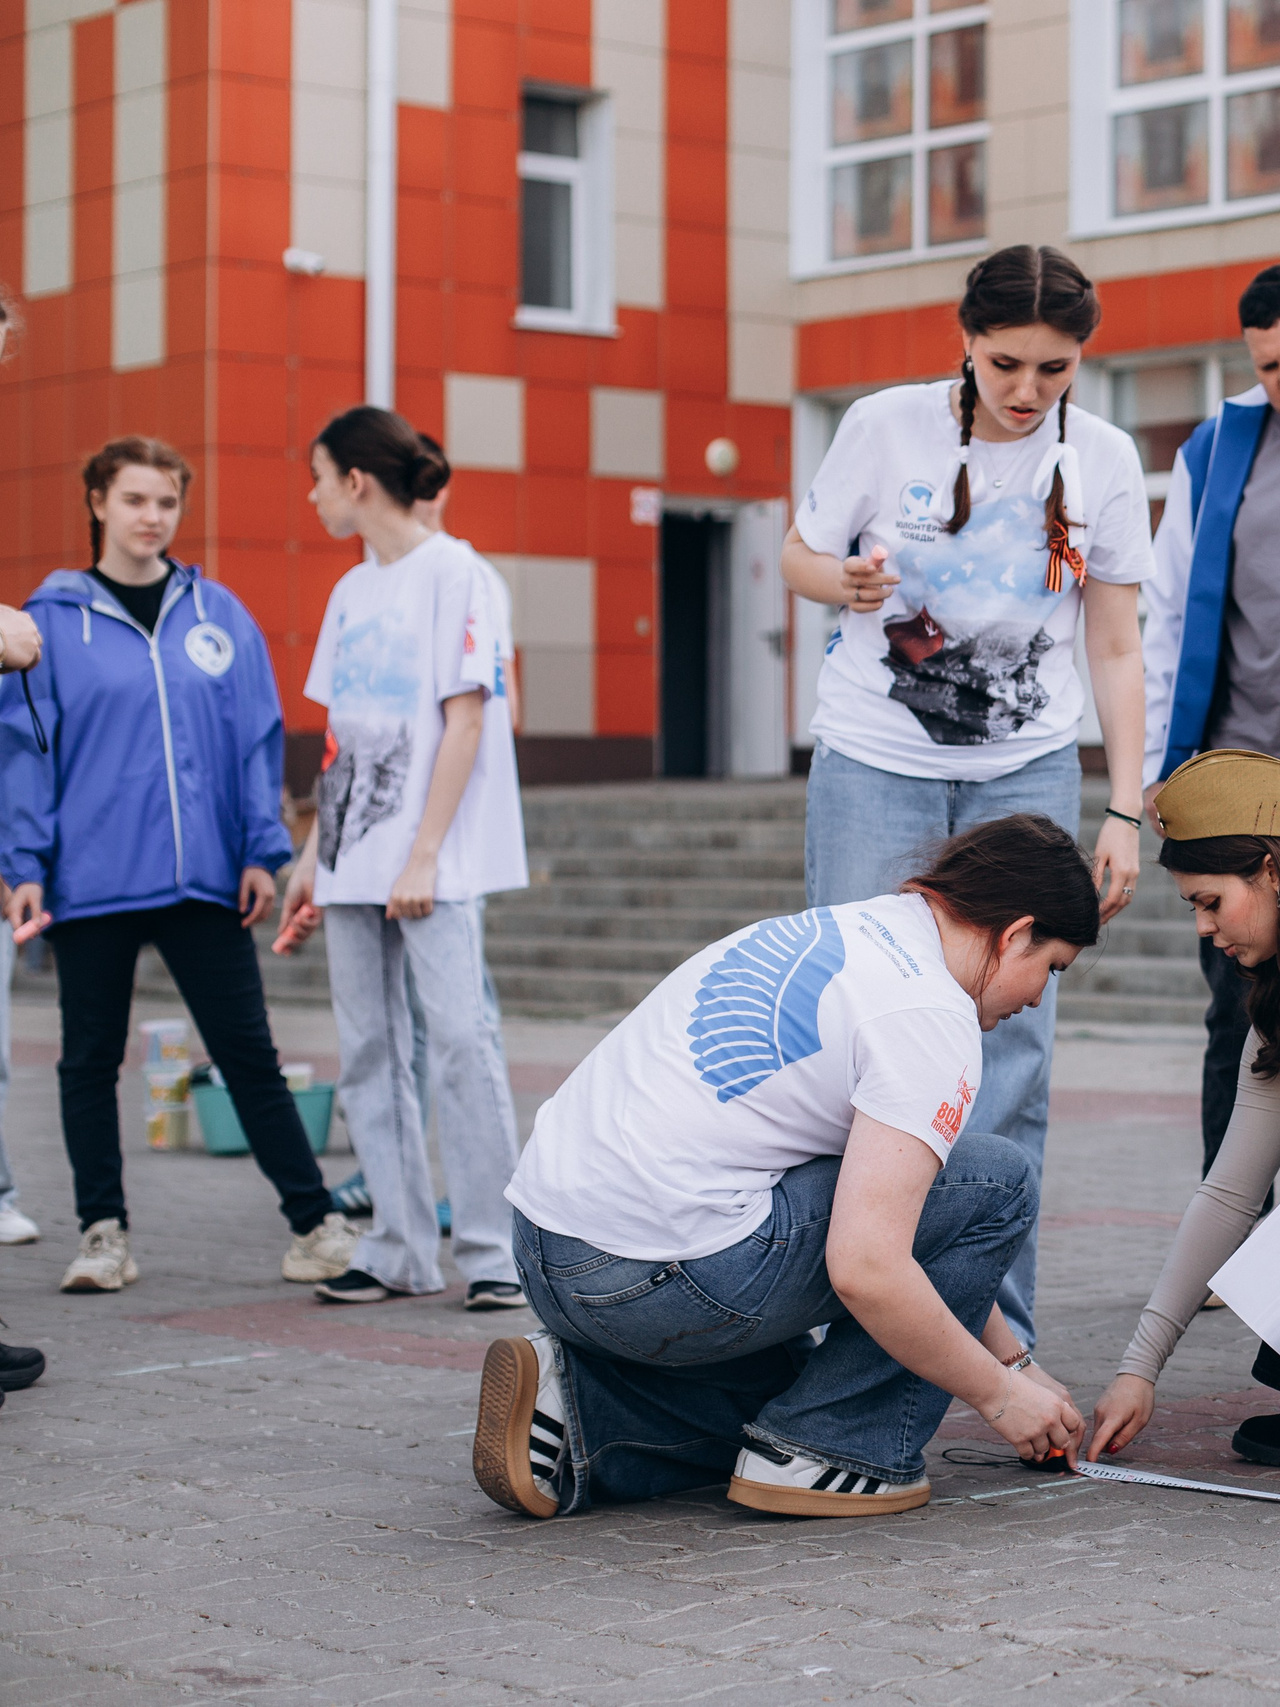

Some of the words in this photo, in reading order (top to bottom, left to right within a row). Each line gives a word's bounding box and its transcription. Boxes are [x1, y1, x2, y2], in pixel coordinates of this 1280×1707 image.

[900, 530, 935, 542] ПОБЕДЫ
[858, 911, 924, 977] #ВООНТЕРЫПОБЕДЫ
[936, 1101, 957, 1127] 80
